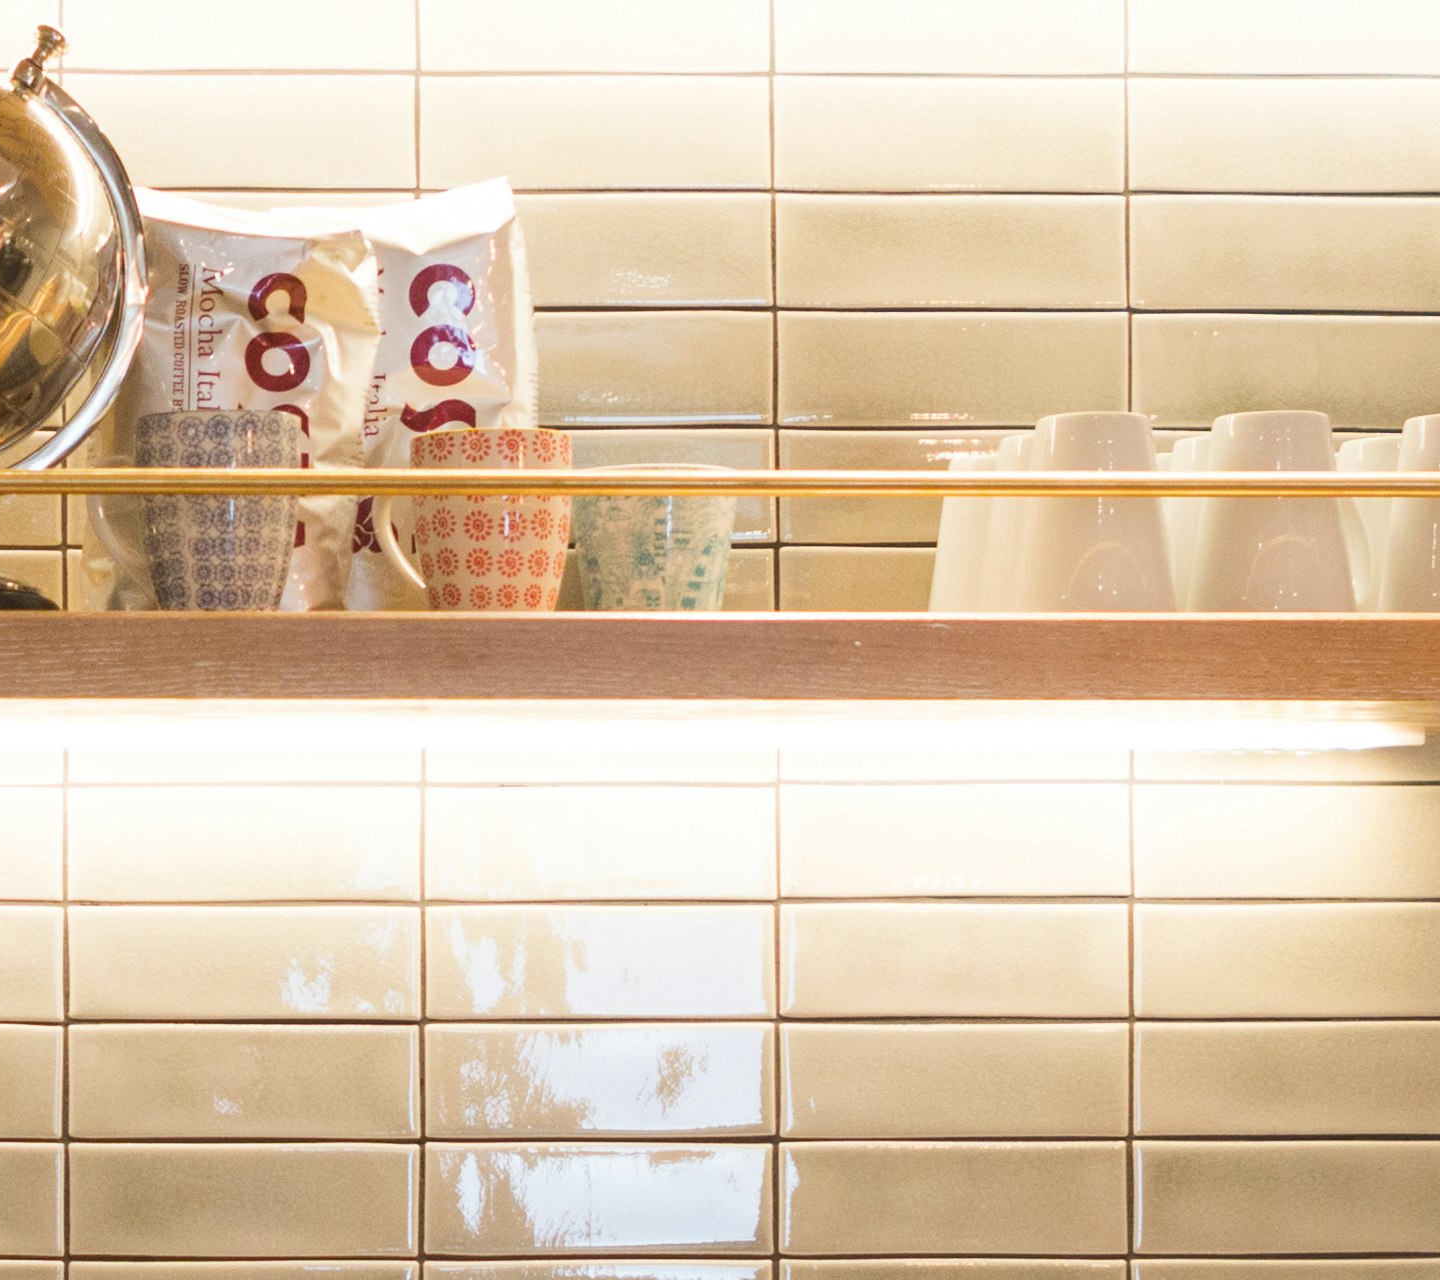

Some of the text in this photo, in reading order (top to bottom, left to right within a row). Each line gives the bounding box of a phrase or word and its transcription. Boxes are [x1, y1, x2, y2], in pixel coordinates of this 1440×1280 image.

[177, 263, 189, 294] SLOW
[173, 300, 187, 349] ROASTED
[196, 266, 227, 411] Mocha Ital
[172, 354, 185, 395] COFFEE
